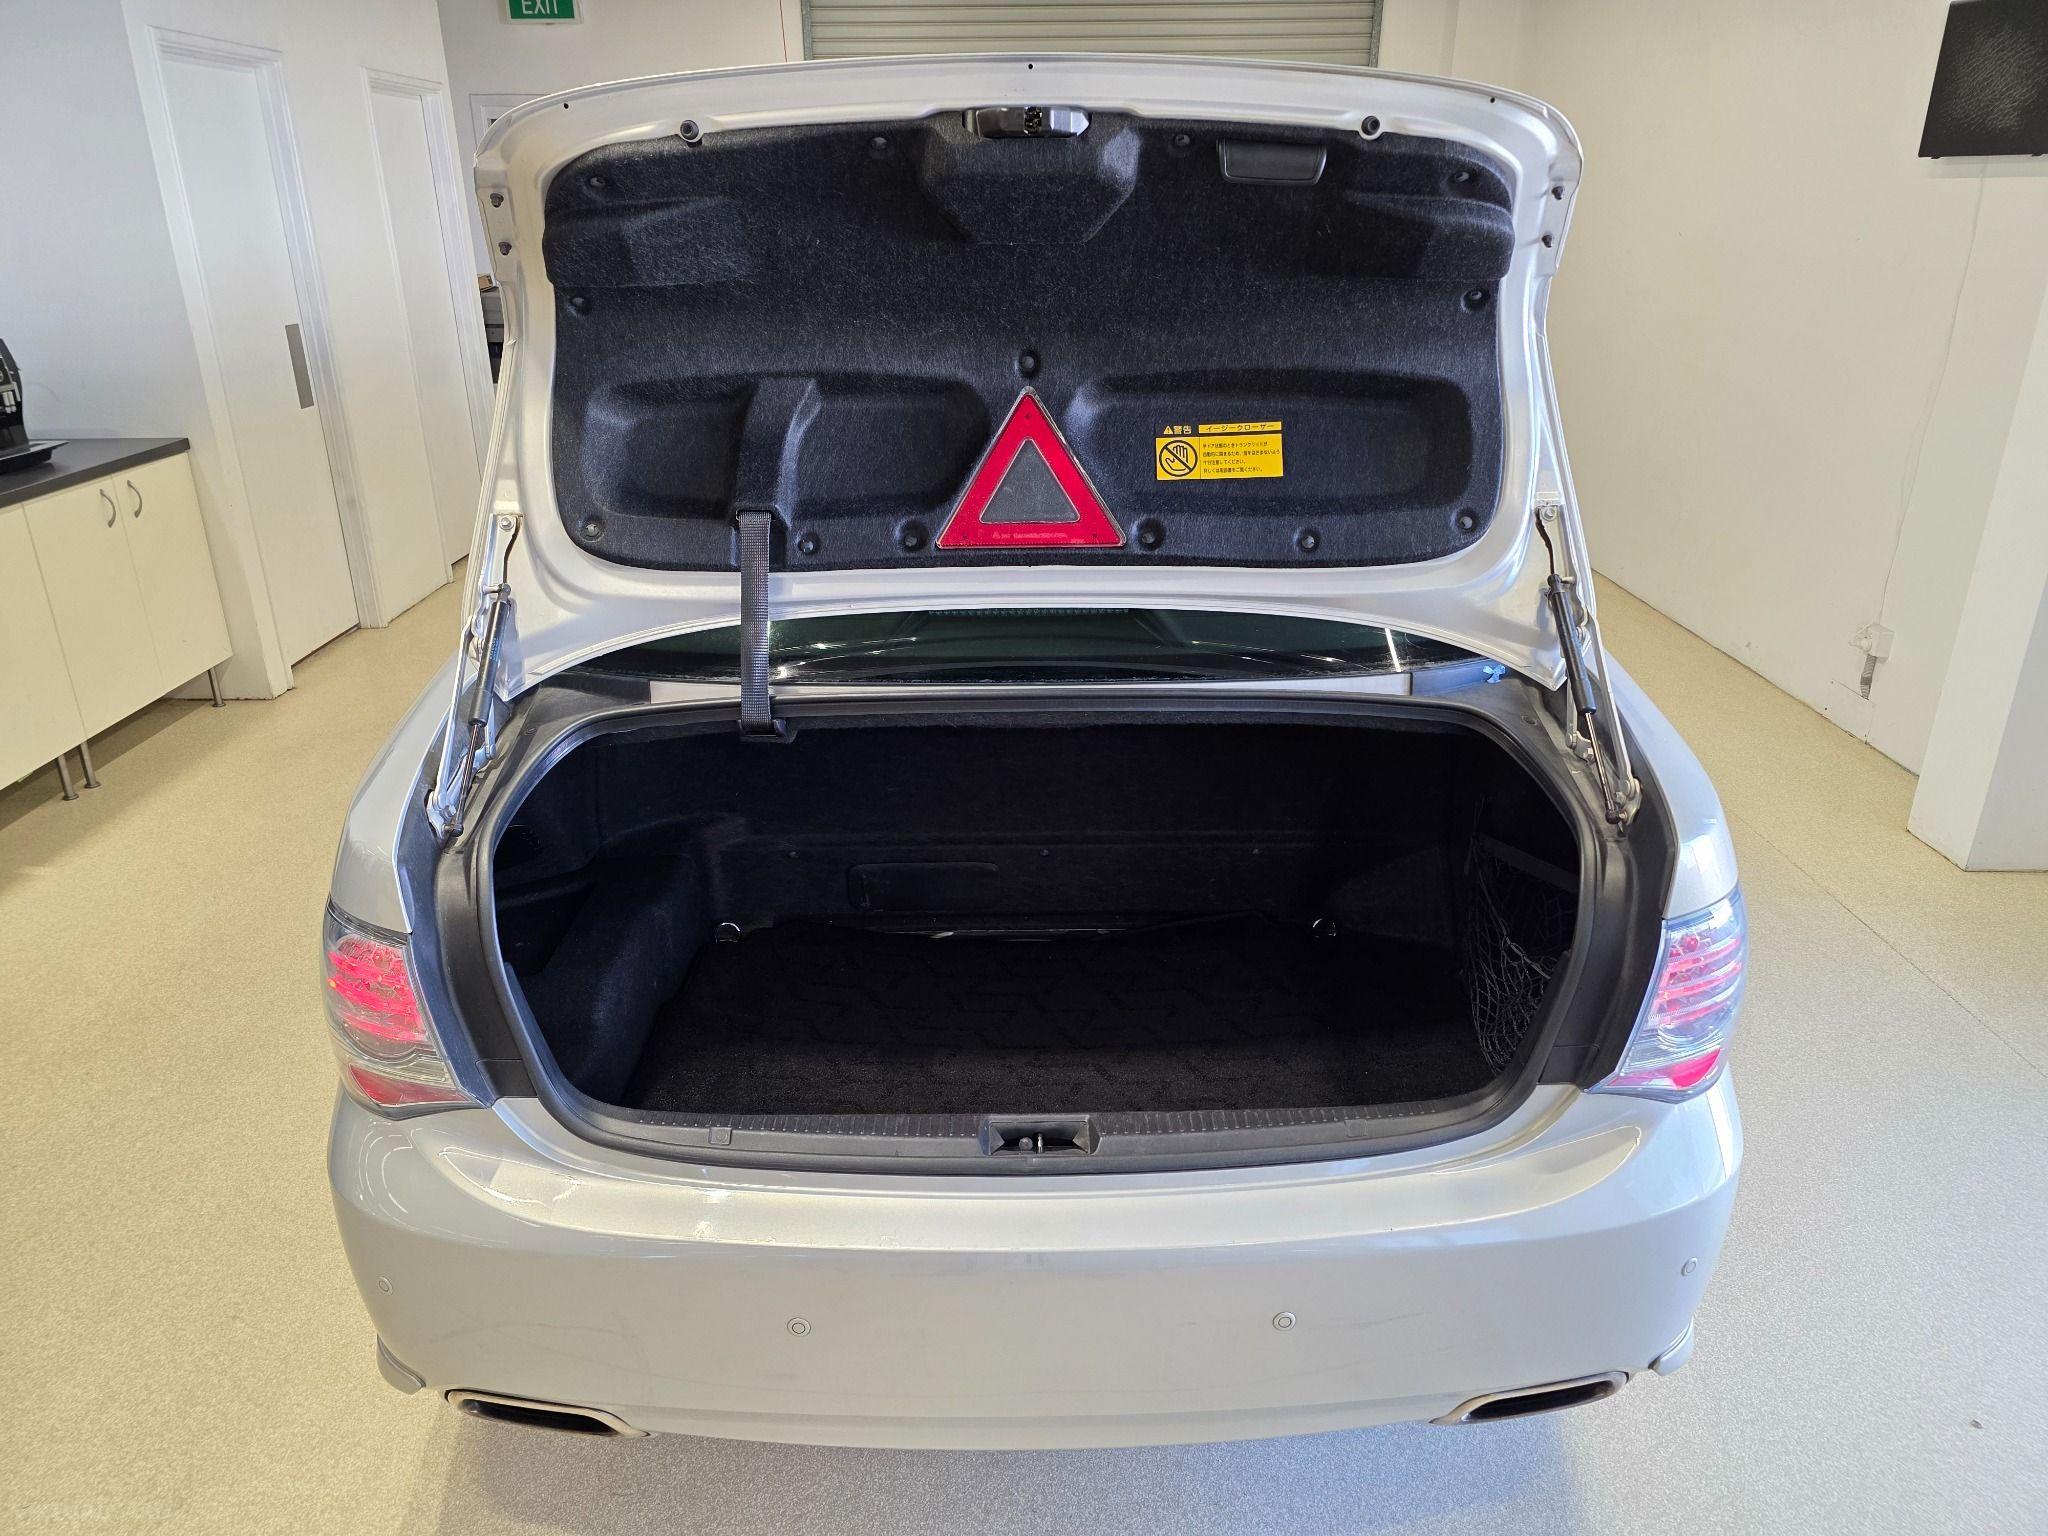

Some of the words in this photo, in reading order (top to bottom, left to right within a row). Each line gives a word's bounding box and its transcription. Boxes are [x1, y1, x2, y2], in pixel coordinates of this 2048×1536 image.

[1173, 425, 1192, 435] 警告
[1205, 424, 1275, 433] イージークローザー
